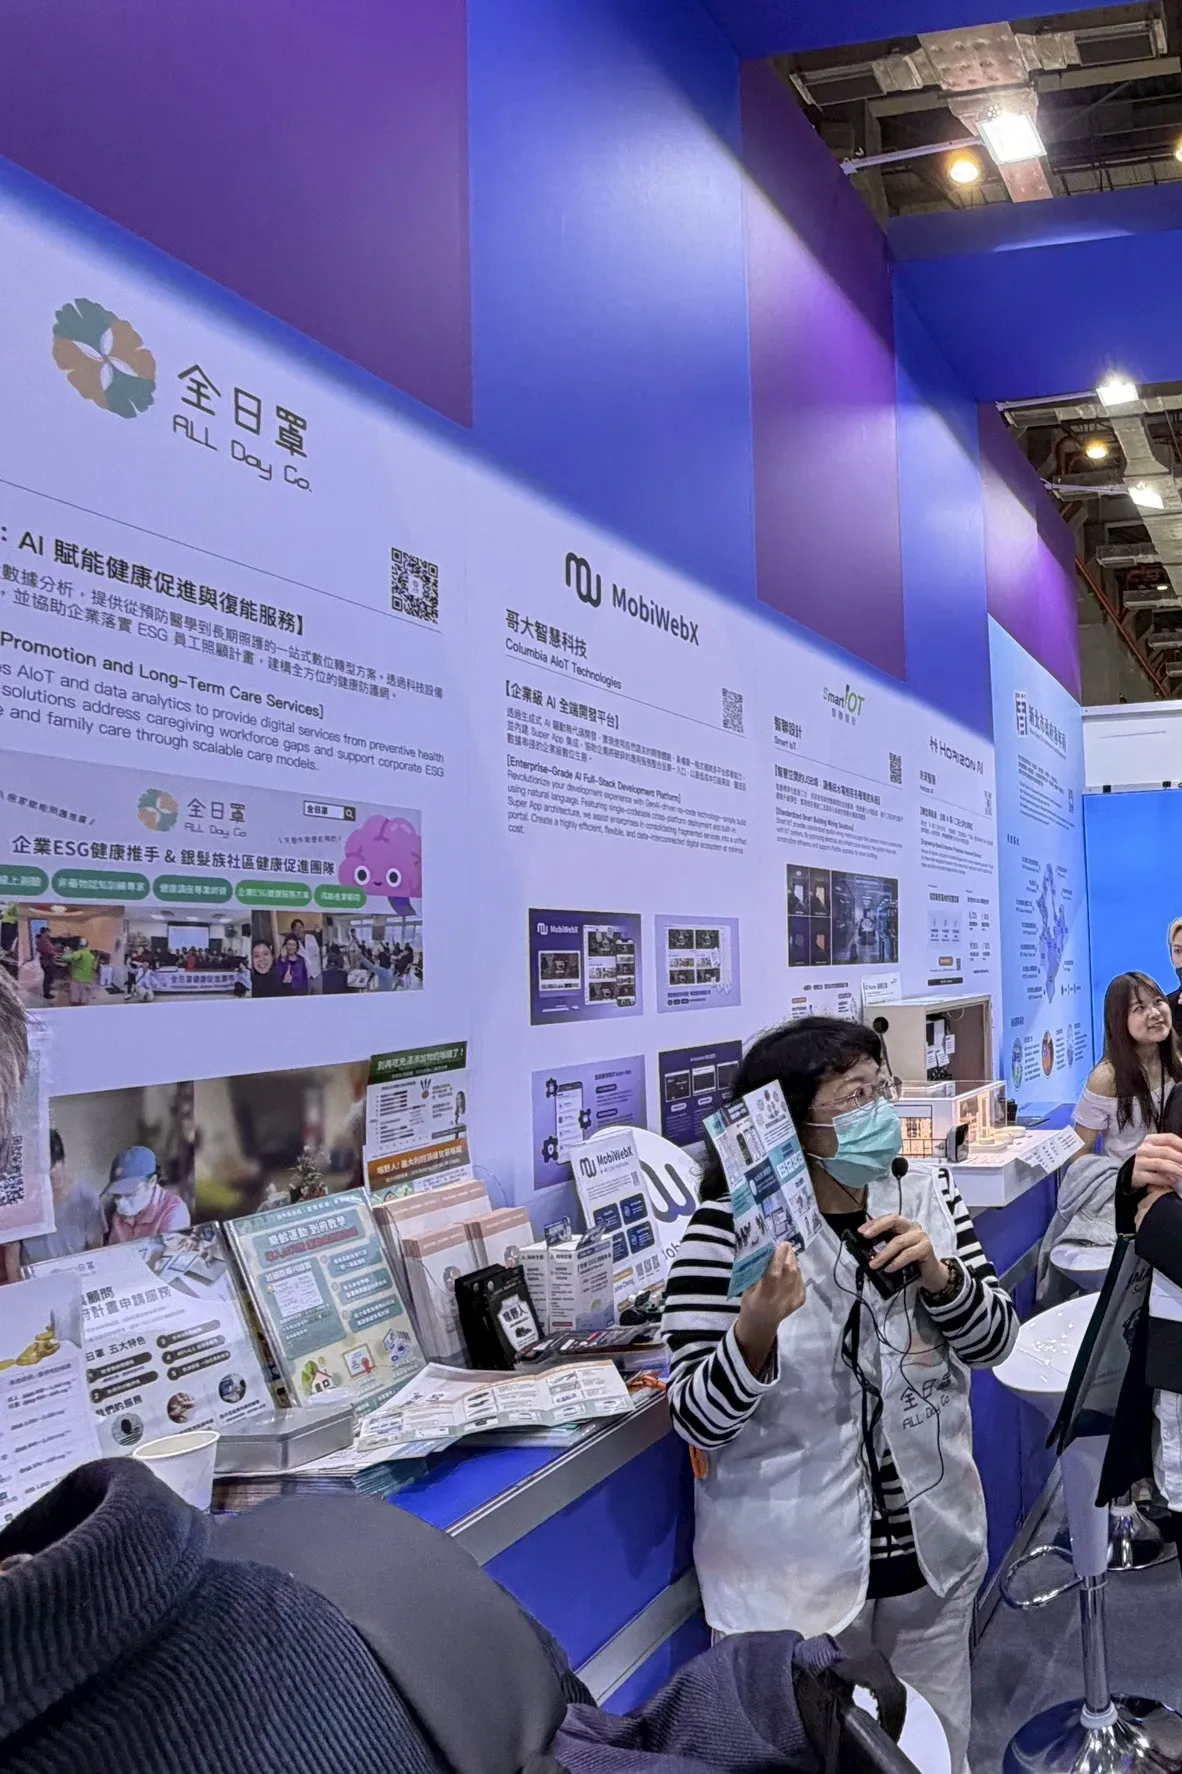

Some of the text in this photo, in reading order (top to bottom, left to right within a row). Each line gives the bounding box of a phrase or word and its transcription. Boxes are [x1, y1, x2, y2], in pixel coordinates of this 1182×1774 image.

[177, 364, 307, 458] 全日罩
[173, 414, 313, 492] ALL Day Co.
[18, 531, 44, 556] AI
[138, 623, 168, 642] ESG
[505, 608, 588, 660] 哥大智慧科技
[612, 583, 699, 646] MobiWebX
[1, 631, 96, 667] Promotion
[103, 656, 133, 676] and
[229, 685, 262, 704] Care
[266, 694, 324, 719] Services]
[505, 637, 622, 690] Columbia AIoT Technologies
[17, 664, 444, 763] AIoT and data analytics to provide digital services from preventive health
[546, 694, 556, 710] AI
[2, 683, 444, 778] solutions address caregiving workforce gaps and support corporate ESG
[9, 707, 319, 771] and family care through scalable care models.
[187, 797, 246, 823] 全日罩
[508, 784, 526, 797] using
[508, 795, 527, 808] Super
[618, 781, 655, 797] Development
[12, 834, 335, 876] 企業ESG健康推手 & 銀髮族社區健康促進團隊
[596, 1145, 634, 1166] MobiWebX
